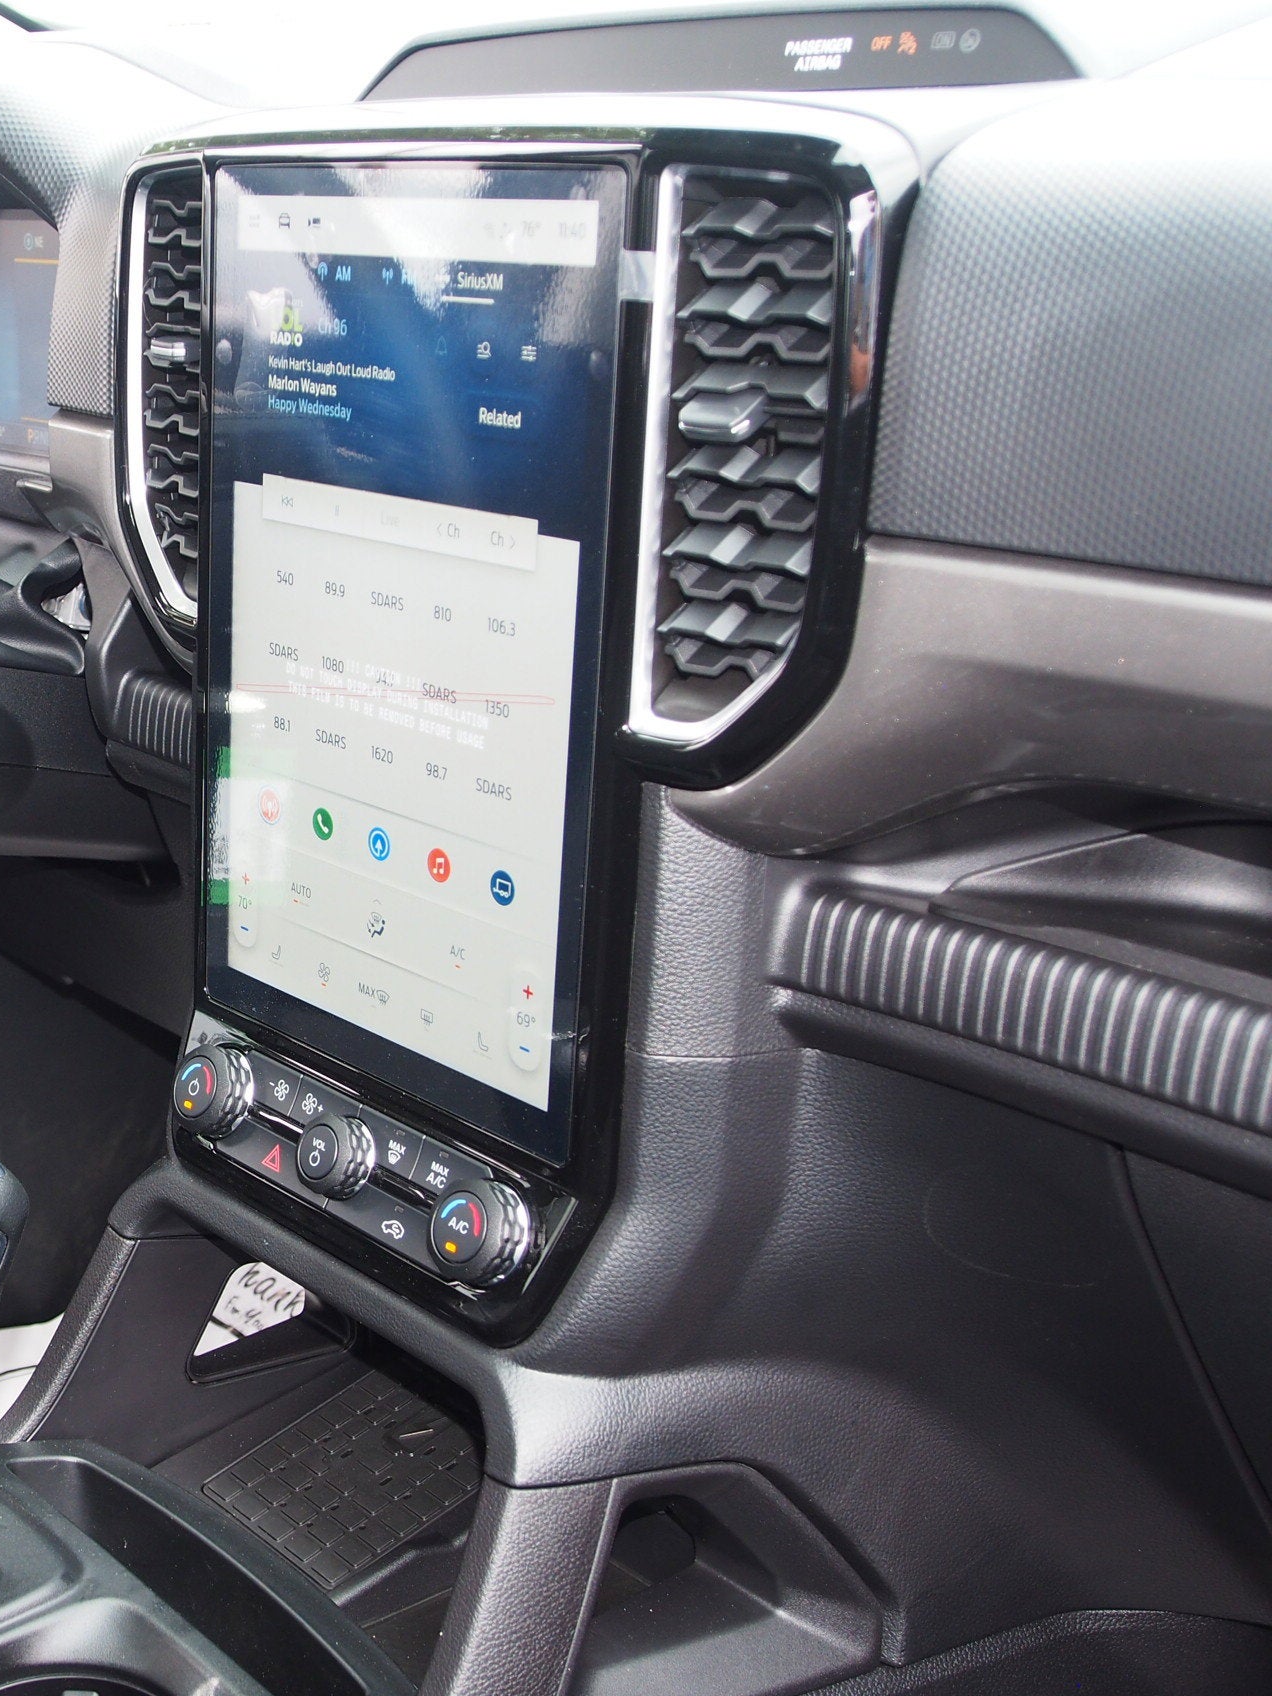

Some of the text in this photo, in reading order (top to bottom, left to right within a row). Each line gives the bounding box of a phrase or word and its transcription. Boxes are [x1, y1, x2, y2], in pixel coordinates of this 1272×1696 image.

[785, 36, 853, 57] PASSENGER
[871, 35, 892, 52] OFF
[793, 54, 841, 71] AIRBAG
[335, 267, 351, 282] AM
[457, 271, 504, 290] SiriusXM
[333, 317, 348, 336] 96
[268, 354, 395, 382] Kevin Hart's Laugh Out Loud Radio
[268, 373, 337, 398] Marlon Wayans
[268, 394, 352, 421] Happy Wednesday
[479, 406, 522, 429] Related
[447, 522, 461, 540] Ch
[491, 530, 505, 548] Ch
[276, 570, 294, 587] 540
[325, 580, 346, 598] 89.9
[371, 591, 404, 612] SDARS
[433, 605, 452, 622] 810
[487, 616, 516, 638] 106.3
[269, 641, 299, 662] SDARS
[321, 655, 344, 674] 1080
[422, 682, 457, 705] SDARS
[485, 698, 510, 719] 1350
[273, 716, 292, 734] 88.1
[315, 728, 347, 750] SDARS
[371, 746, 394, 765] 1620
[425, 762, 448, 782] 98.7
[475, 777, 512, 802] SDARS
[290, 881, 312, 900] AUTO
[450, 944, 466, 962] A/C
[358, 981, 376, 999] MAX
[516, 1010, 536, 1030] 69°
[312, 1136, 327, 1152] VOL
[388, 1139, 406, 1155] MAX
[431, 1160, 449, 1178] MAX
[425, 1172, 446, 1189] A/C
[448, 1216, 468, 1235] A/C
